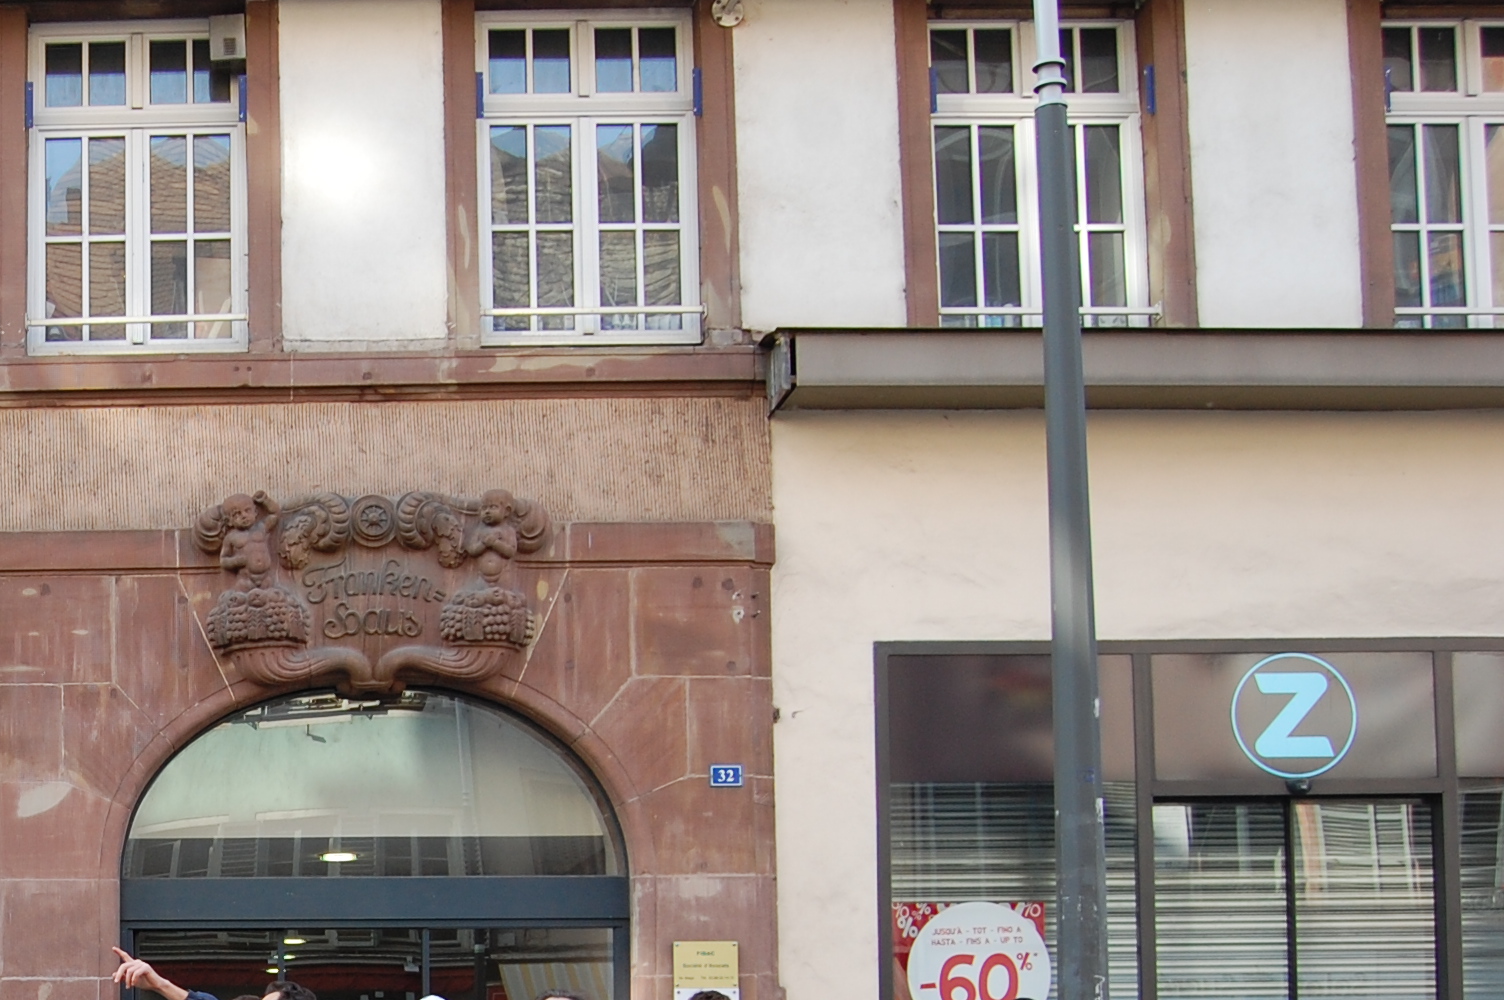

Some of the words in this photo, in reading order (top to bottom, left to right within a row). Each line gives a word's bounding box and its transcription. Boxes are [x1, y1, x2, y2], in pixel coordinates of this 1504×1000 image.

[1254, 671, 1335, 758] Z
[717, 769, 735, 783] 32
[931, 937, 956, 945] HASTA
